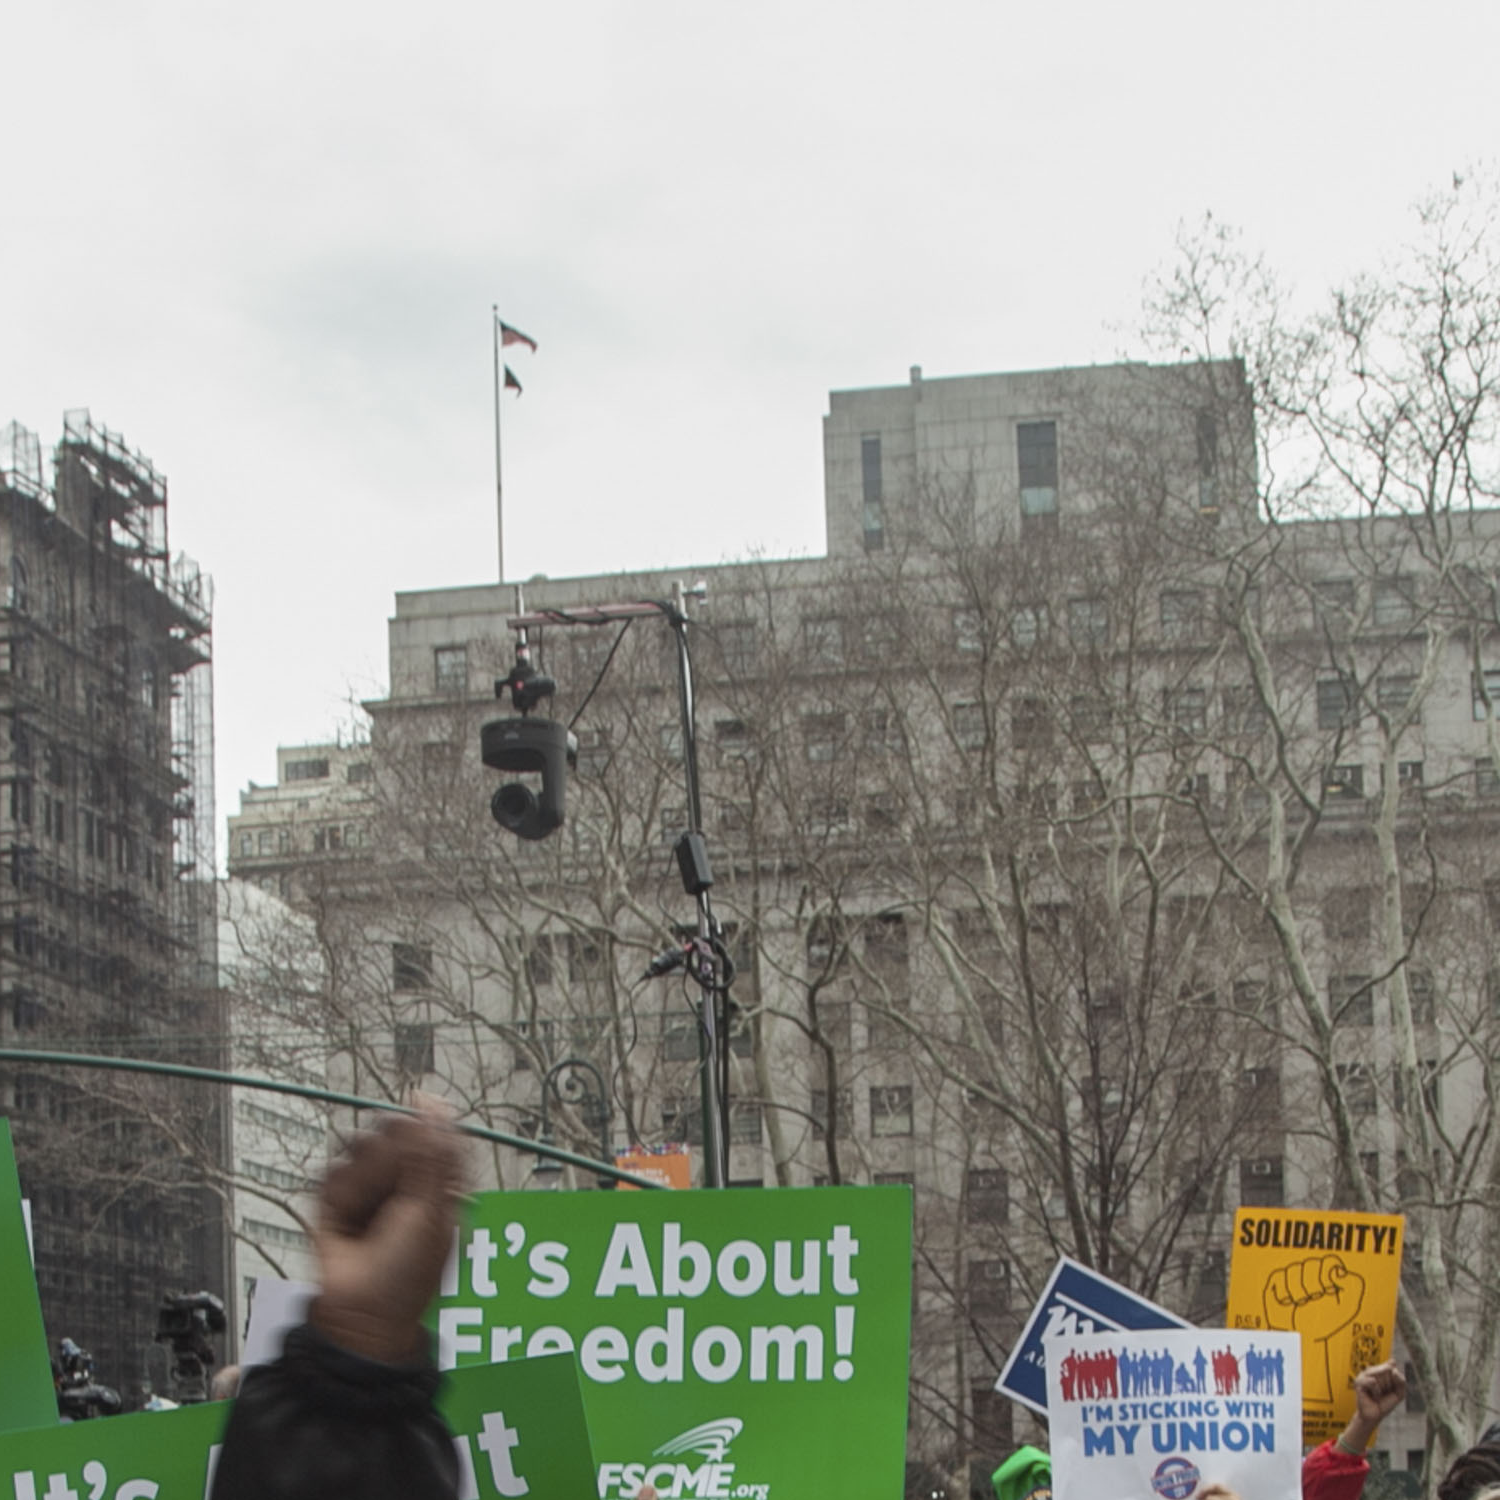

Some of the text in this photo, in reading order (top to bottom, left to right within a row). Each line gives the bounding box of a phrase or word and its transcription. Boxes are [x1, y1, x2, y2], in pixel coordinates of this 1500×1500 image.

[1239, 1217, 1396, 1256] SOLIDARITY!
[595, 1222, 860, 1298] About
[438, 1305, 856, 1384] Freedom!
[1082, 1400, 1275, 1423] I'M STICKING WITH
[1084, 1425, 1140, 1457] MY
[1151, 1421, 1275, 1453] UNION
